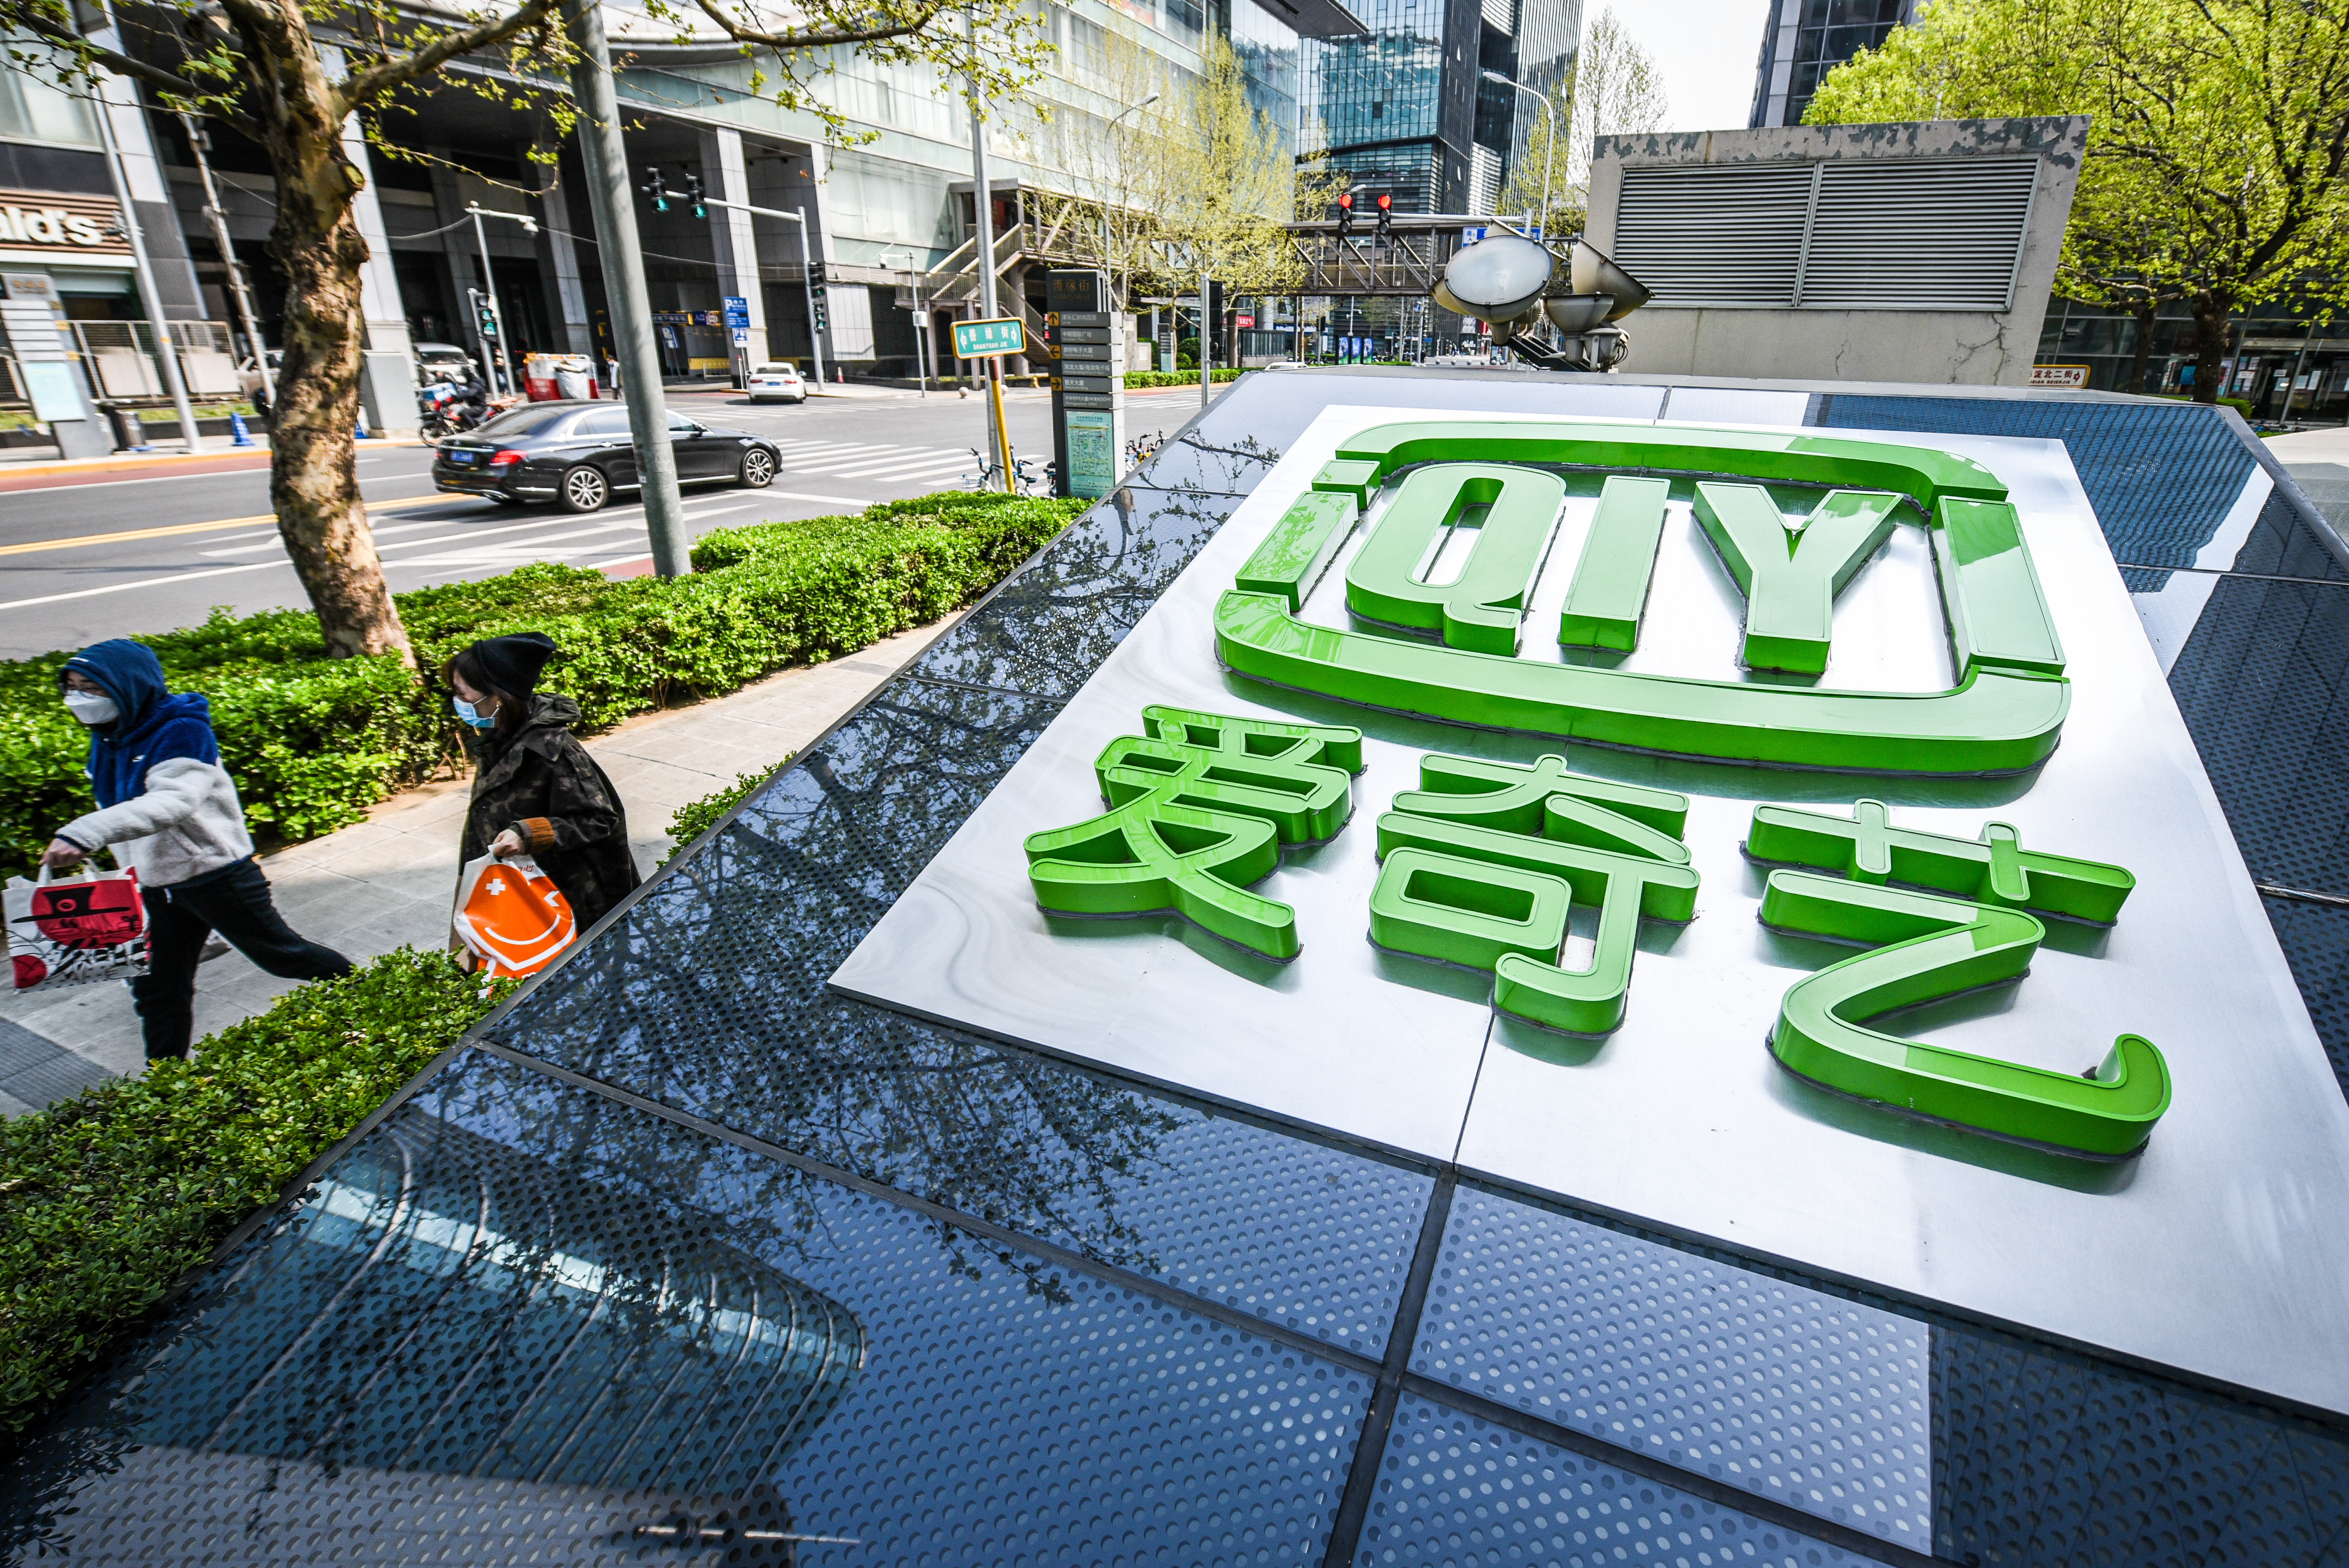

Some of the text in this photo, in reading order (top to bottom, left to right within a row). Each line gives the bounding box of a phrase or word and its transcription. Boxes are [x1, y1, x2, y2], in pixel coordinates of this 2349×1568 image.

[1053, 279, 1090, 291] 善缘街
[725, 299, 732, 310] P
[969, 326, 1008, 342] 善缘街
[1024, 702, 2172, 1165] 爱奇艺
